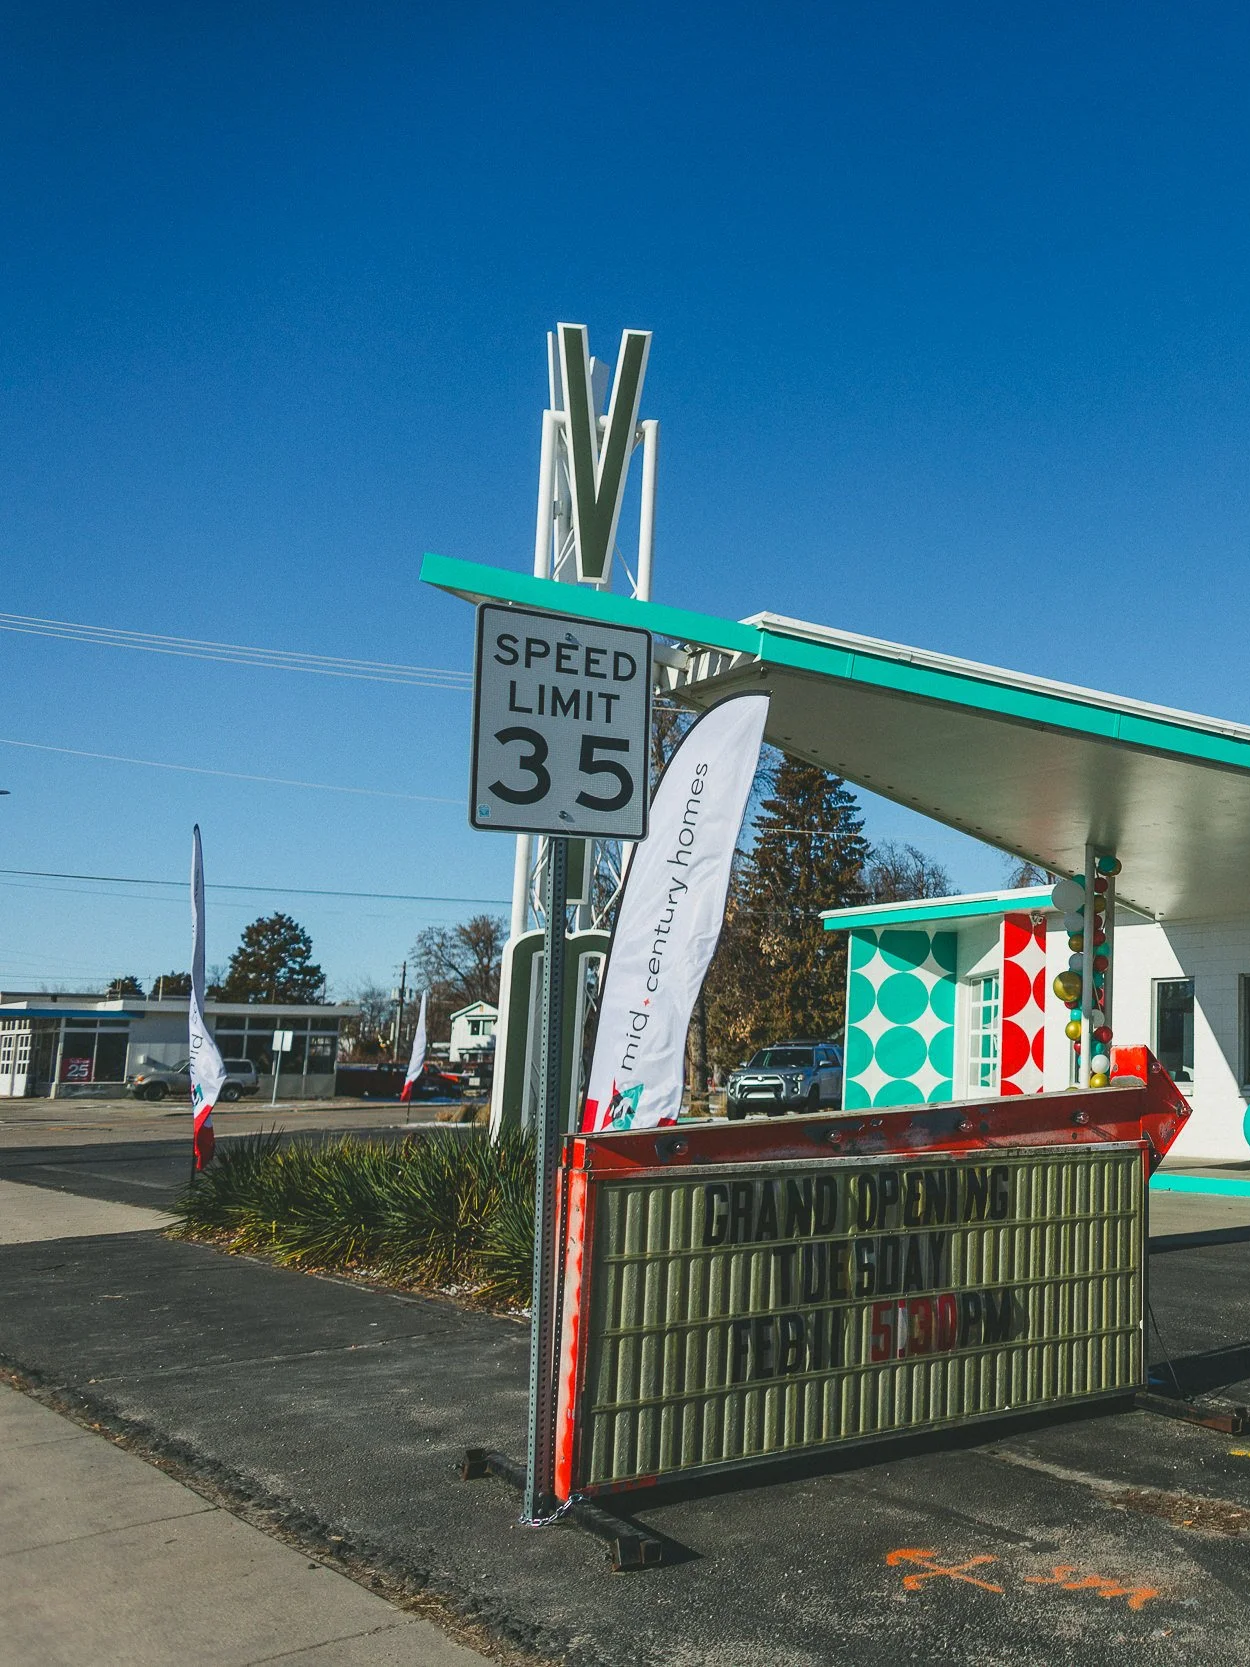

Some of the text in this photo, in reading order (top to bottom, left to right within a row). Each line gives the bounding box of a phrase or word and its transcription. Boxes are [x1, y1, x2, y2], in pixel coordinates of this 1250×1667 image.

[557, 322, 653, 583] V
[493, 633, 637, 682] SPEED
[508, 680, 620, 723] LIMIT
[488, 726, 634, 812] 35
[621, 762, 708, 1071] mid century homes
[67, 1064, 89, 1077] 25
[702, 1165, 1009, 1246] GRAND OPENING
[773, 1232, 949, 1306] TUESDAY
